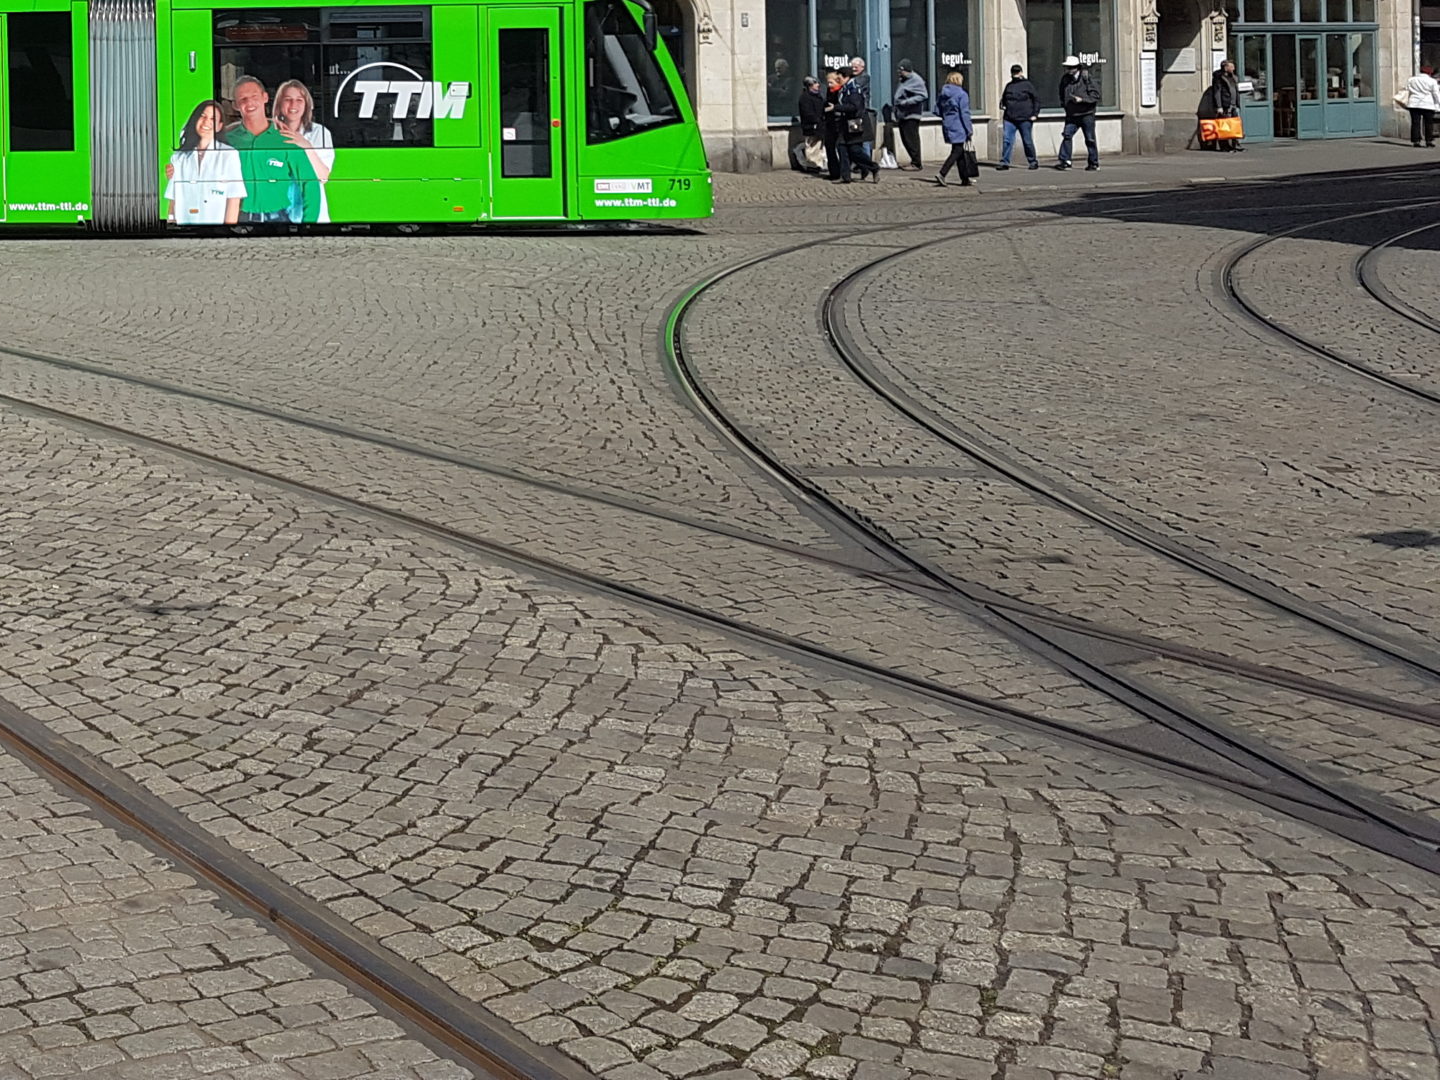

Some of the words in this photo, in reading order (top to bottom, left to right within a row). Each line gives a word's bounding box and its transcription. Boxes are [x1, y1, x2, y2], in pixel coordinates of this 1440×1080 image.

[824, 54, 852, 69] tegut.
[941, 52, 972, 68] tegut...
[353, 81, 469, 119] TTM
[668, 178, 691, 191] 719
